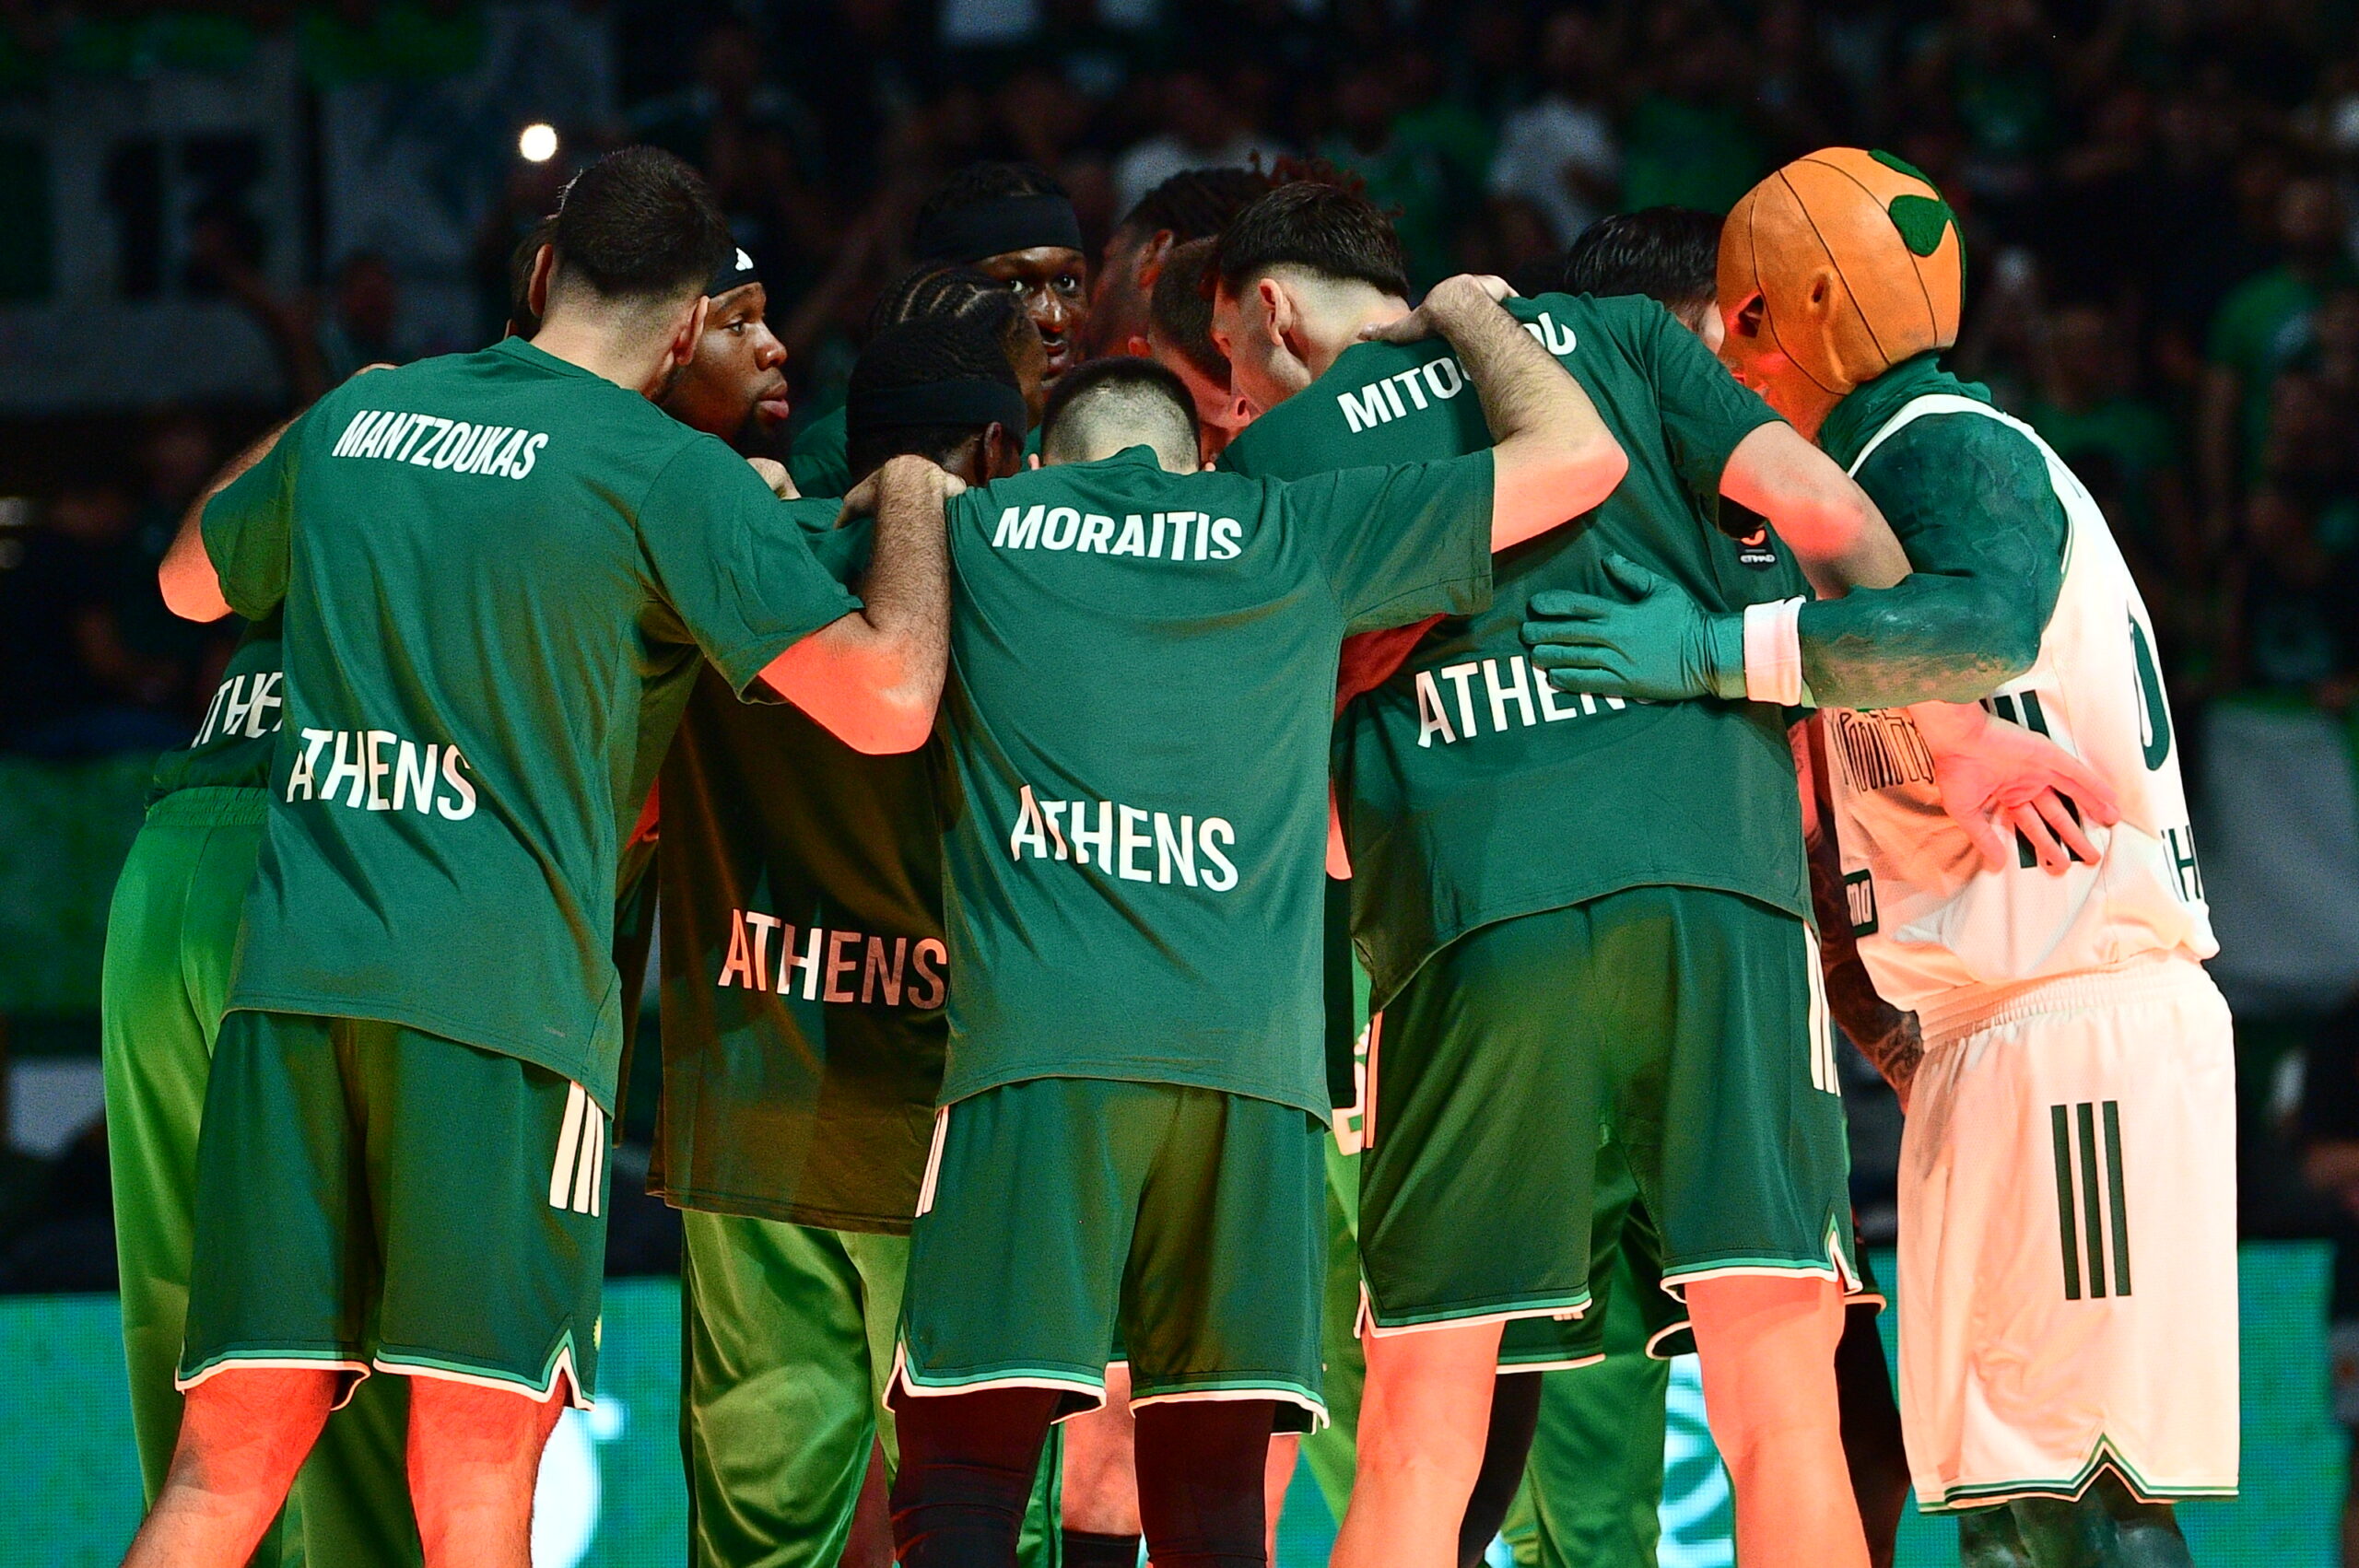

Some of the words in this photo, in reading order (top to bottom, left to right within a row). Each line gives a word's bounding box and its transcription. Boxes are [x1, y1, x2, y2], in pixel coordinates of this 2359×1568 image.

[1336, 311, 1578, 434] MITOU
[331, 410, 549, 480] MANTZOUKAS
[992, 504, 1242, 561] MORAITIS
[1413, 655, 1657, 749] ATHE
[286, 727, 476, 821] ATHENS
[1010, 784, 1239, 892] ATHENS
[717, 907, 947, 1011] ATHENS
